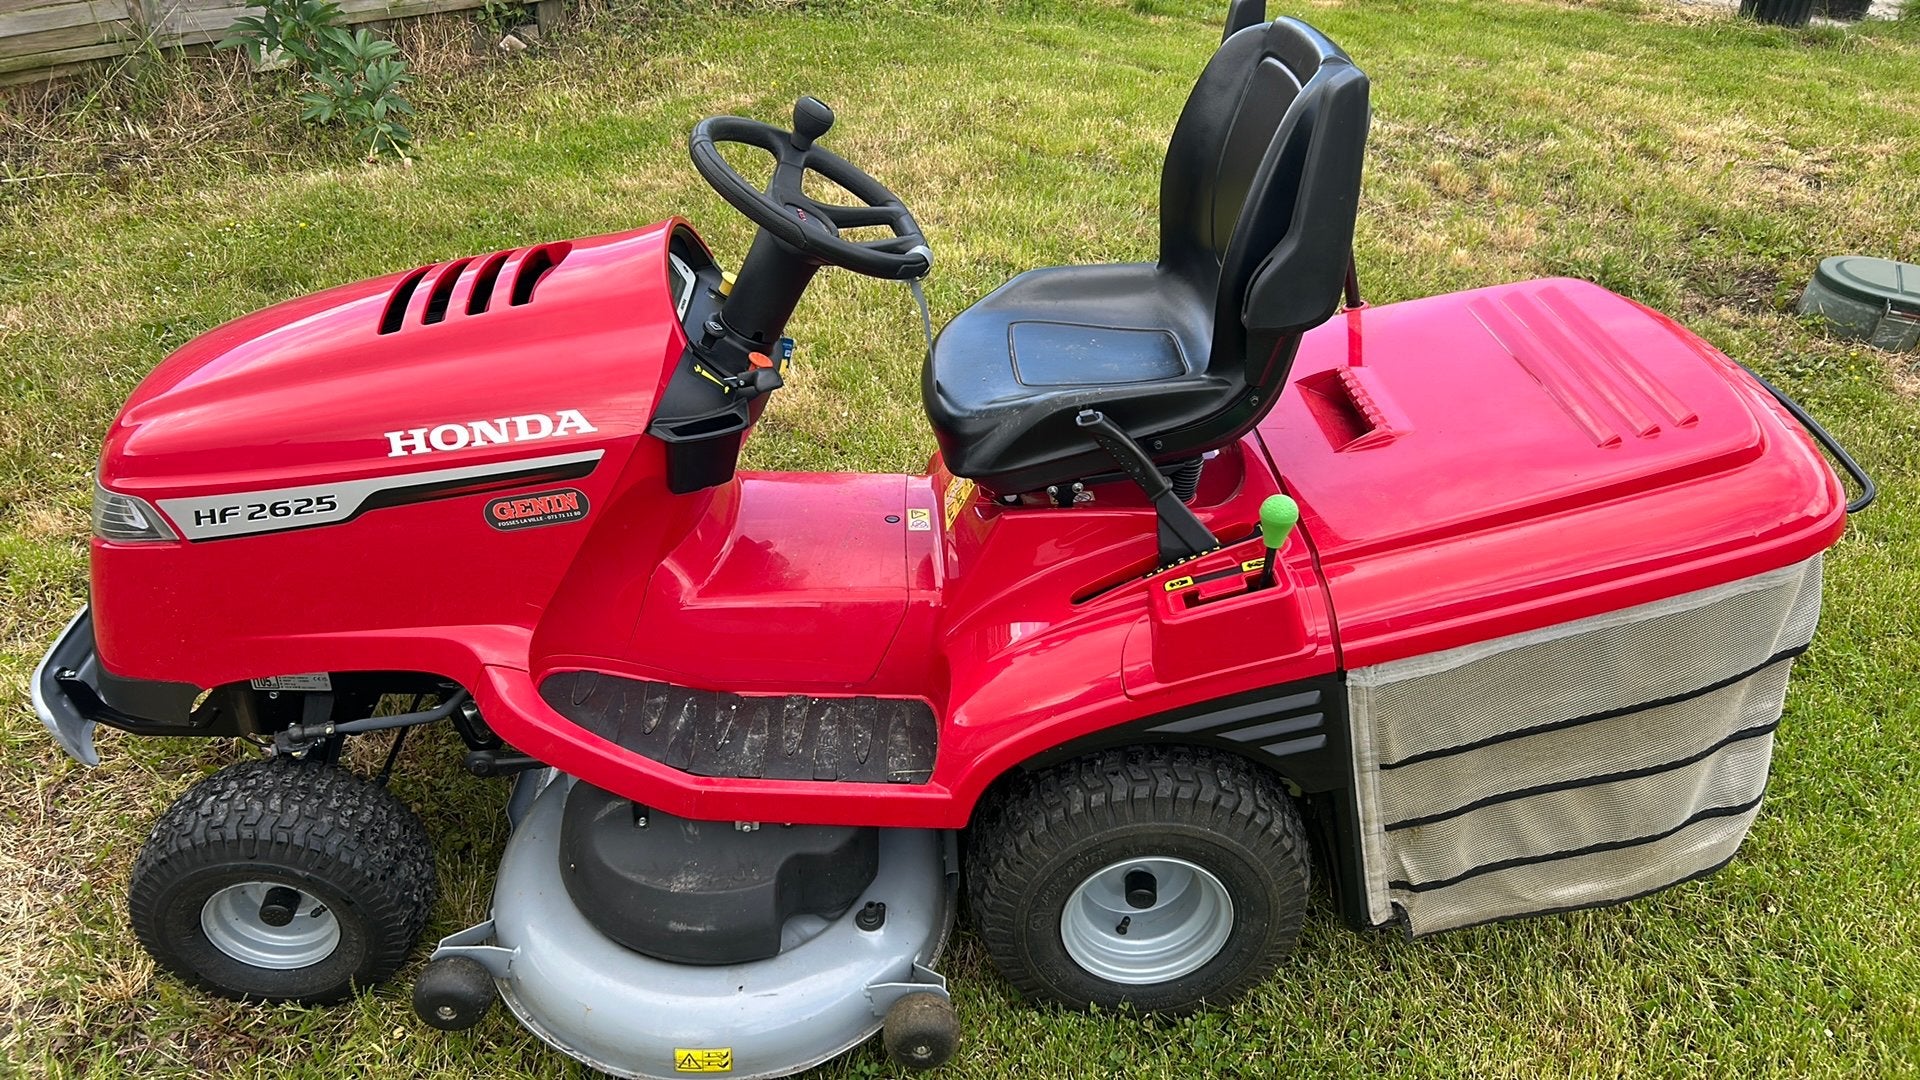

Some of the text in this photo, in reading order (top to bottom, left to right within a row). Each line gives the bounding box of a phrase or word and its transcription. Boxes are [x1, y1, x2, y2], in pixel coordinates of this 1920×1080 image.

[384, 408, 599, 458] HONDA
[193, 494, 339, 527] HF 2625
[492, 492, 579, 520] GENIN
[498, 519, 520, 527] FOSSES
